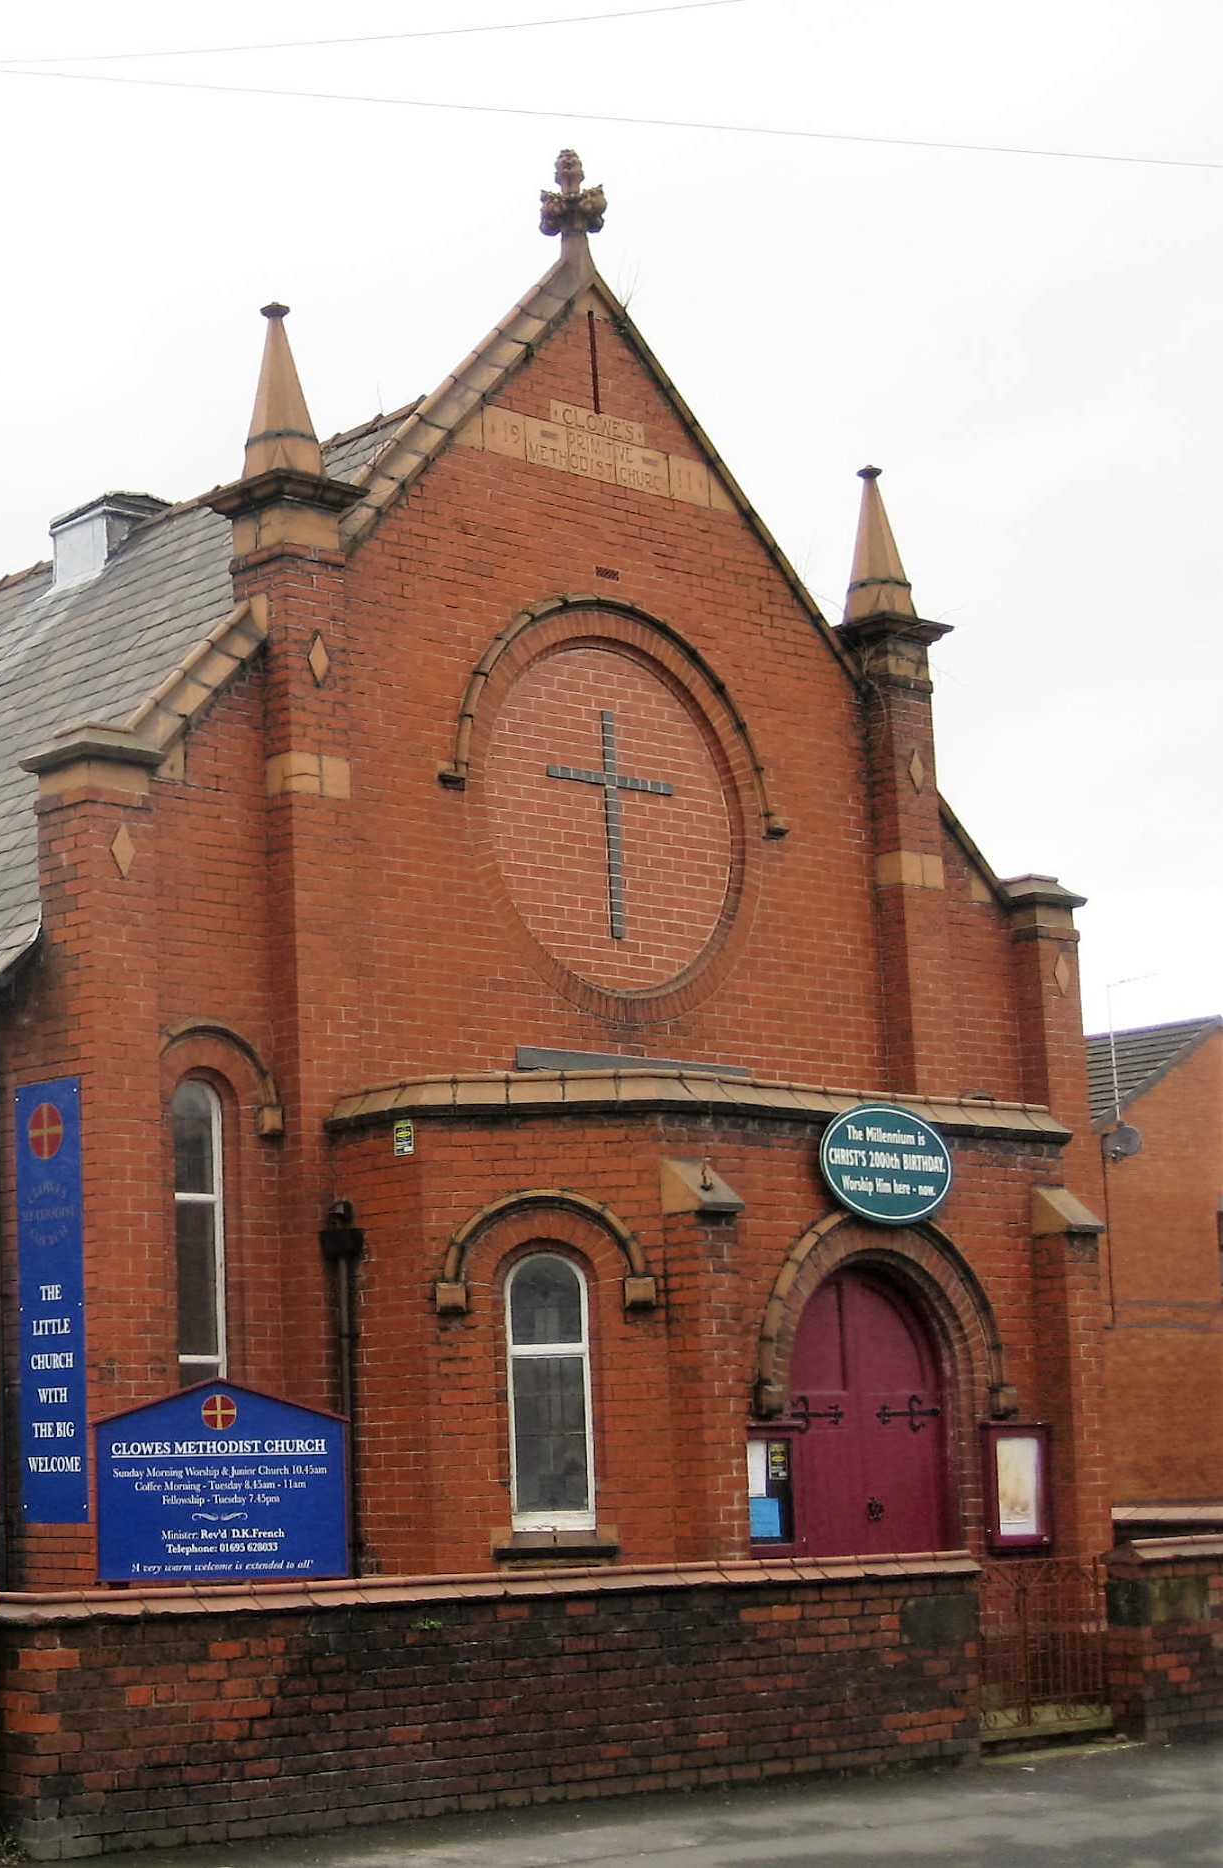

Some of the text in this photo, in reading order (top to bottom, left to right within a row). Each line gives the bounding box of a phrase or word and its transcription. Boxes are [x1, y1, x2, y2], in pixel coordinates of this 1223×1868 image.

[562, 408, 634, 441] CLOWES
[526, 441, 613, 480] METHODIST
[846, 1125, 926, 1146] The Millennium is
[828, 1147, 946, 1174] CHRIST'S 2000th BIRTHDAY.
[841, 1175, 874, 1197] Worship
[875, 1177, 892, 1194] Him
[893, 1178, 911, 1195] here
[918, 1185, 936, 1197] now.
[39, 1284, 62, 1301] THE
[32, 1318, 71, 1336] LITTLE
[30, 1352, 74, 1370] CHURCH
[37, 1387, 68, 1404] WITH
[32, 1421, 75, 1439] THE BIG
[111, 1438, 326, 1455] CLOWES METHODIST CHURCH
[27, 1456, 82, 1473] WELCOME
[113, 1464, 327, 1480] Sunday Morning Worship & Junior Church 10.45am
[134, 1481, 163, 1492] Coffee
[164, 1480, 201, 1493] Morning
[209, 1479, 243, 1492] Tuesday
[244, 1479, 276, 1490] 8.45am
[283, 1479, 307, 1489] 11am
[162, 1494, 205, 1507] Fellowship
[212, 1493, 247, 1506] Tuesday
[248, 1493, 281, 1506] 7.45pm
[200, 1528, 227, 1540] Rev'd
[165, 1541, 278, 1556] Telephone: 01695 628033
[143, 1564, 162, 1575] very
[164, 1564, 192, 1572] warm
[194, 1561, 233, 1572] welcome
[235, 1560, 243, 1570] is
[245, 1559, 284, 1570] extended
[286, 1560, 295, 1569] to
